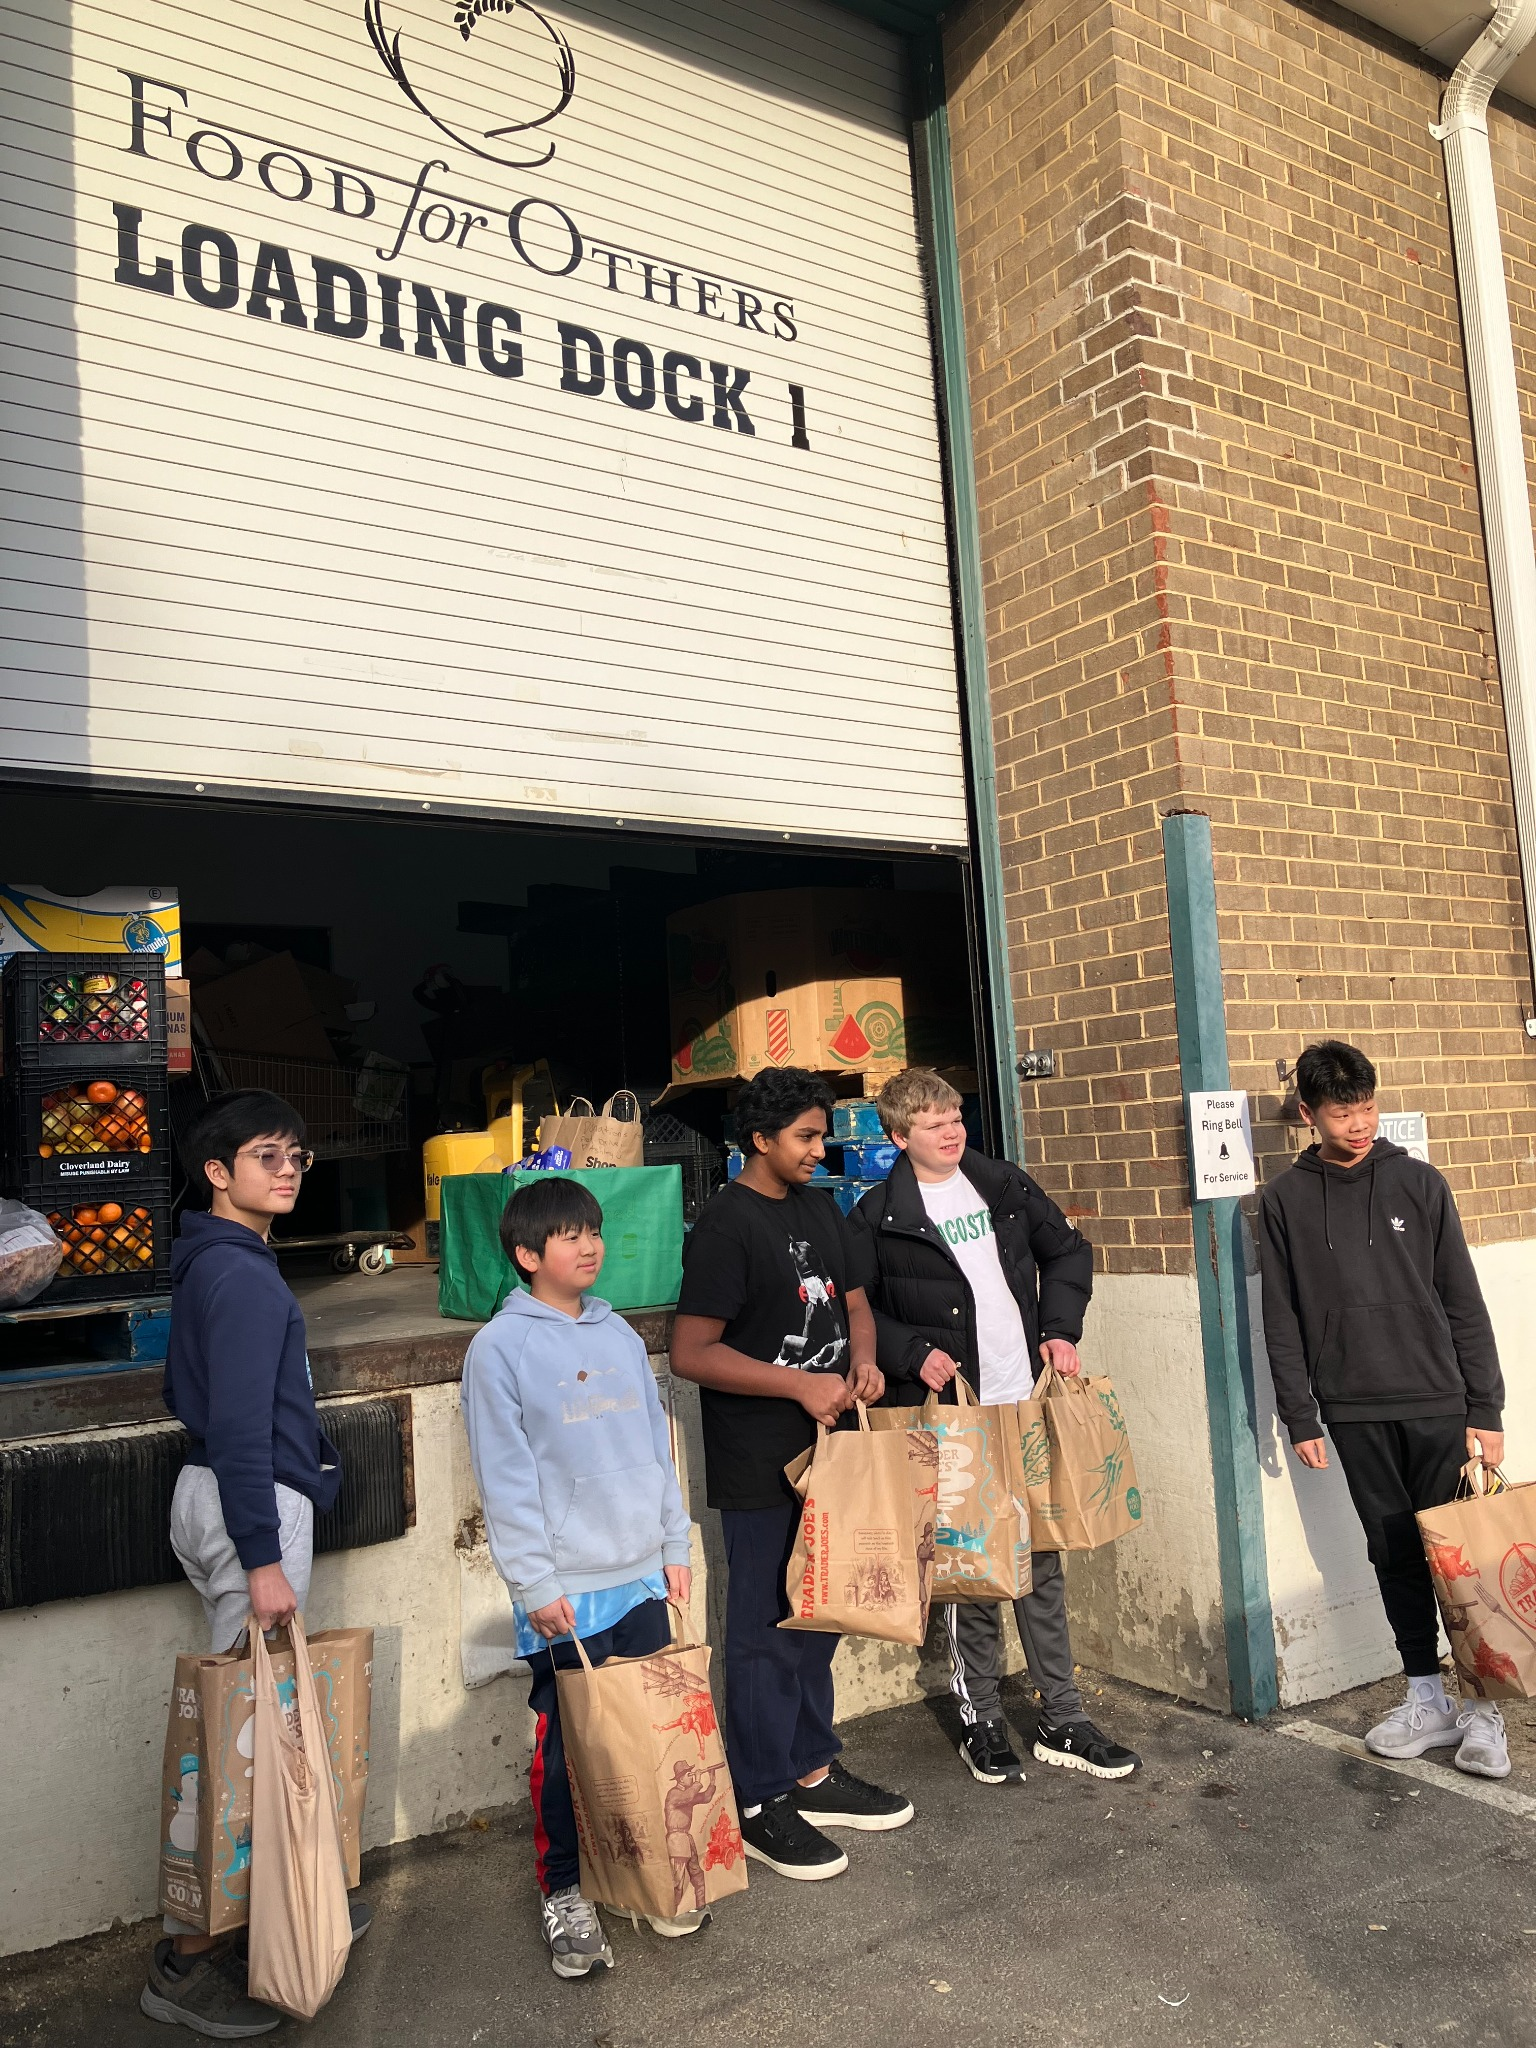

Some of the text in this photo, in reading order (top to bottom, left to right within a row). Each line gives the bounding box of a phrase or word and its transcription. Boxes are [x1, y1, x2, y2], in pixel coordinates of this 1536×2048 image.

[117, 69, 798, 342] FOOD for OTHERS
[112, 201, 810, 450] LOADING DOCK 1
[166, 1012, 185, 1021] IUM
[167, 1024, 187, 1034] NAS
[1207, 1099, 1235, 1110] Please
[1202, 1118, 1243, 1132] Ring Bell
[60, 1160, 130, 1170] Cloverland Dairy
[1203, 1171, 1249, 1184] For Service
[801, 1498, 816, 1619] TRADER JOE'S
